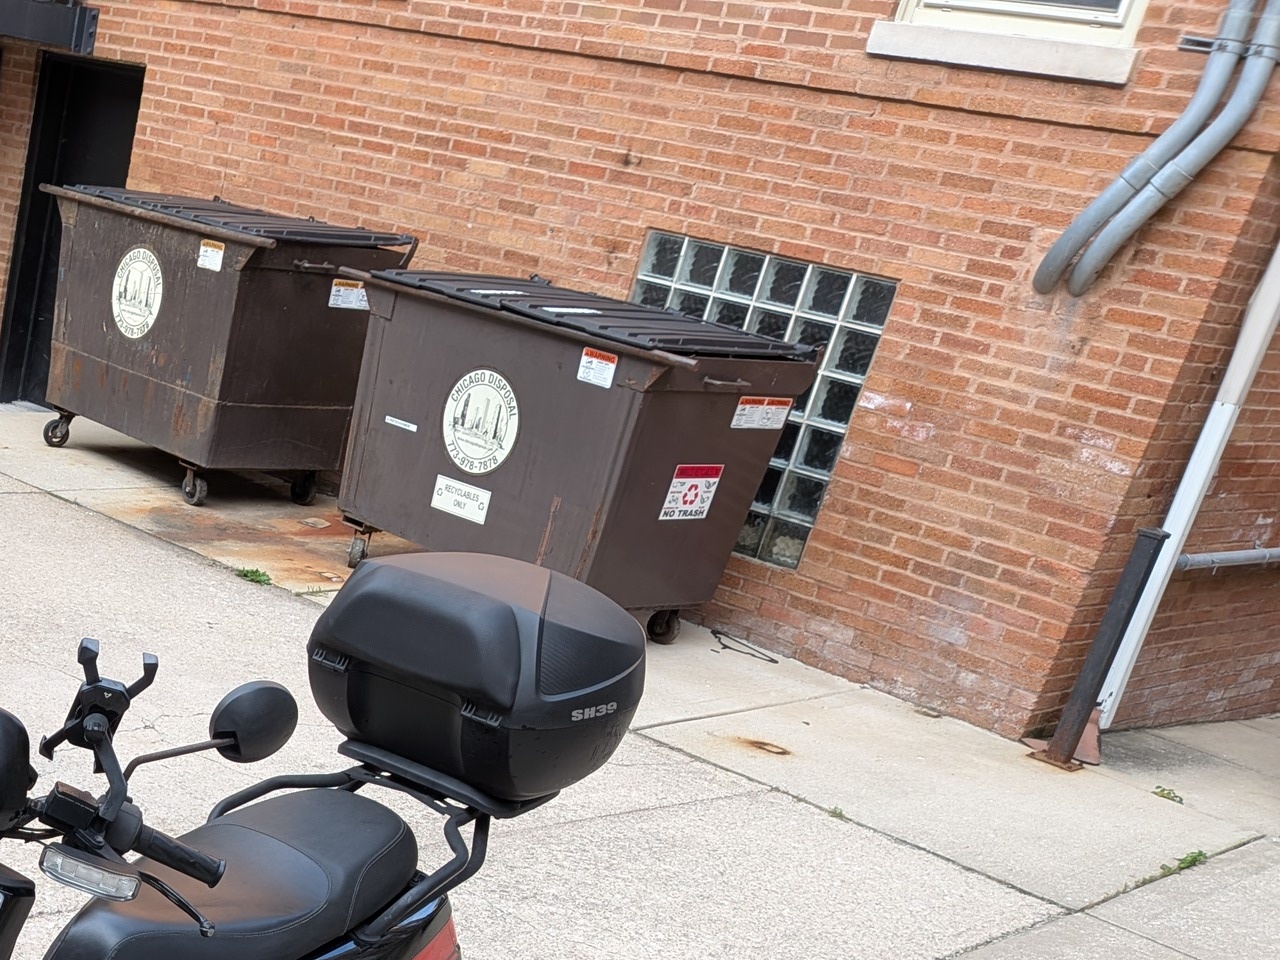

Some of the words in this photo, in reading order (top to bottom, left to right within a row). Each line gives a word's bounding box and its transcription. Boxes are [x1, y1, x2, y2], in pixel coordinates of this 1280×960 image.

[117, 250, 141, 279] CHICAGO
[141, 250, 162, 286] DISPOSAL
[587, 350, 616, 365] WARNING
[451, 371, 486, 402] CHICAGO
[488, 373, 517, 417] DISPOSAL
[447, 440, 498, 471] 773-978-7878
[445, 483, 480, 503] RECYCLABLES
[453, 498, 468, 510] ONLY
[662, 510, 676, 518] NO
[677, 509, 706, 518] TRASH
[571, 701, 618, 721] SH39
